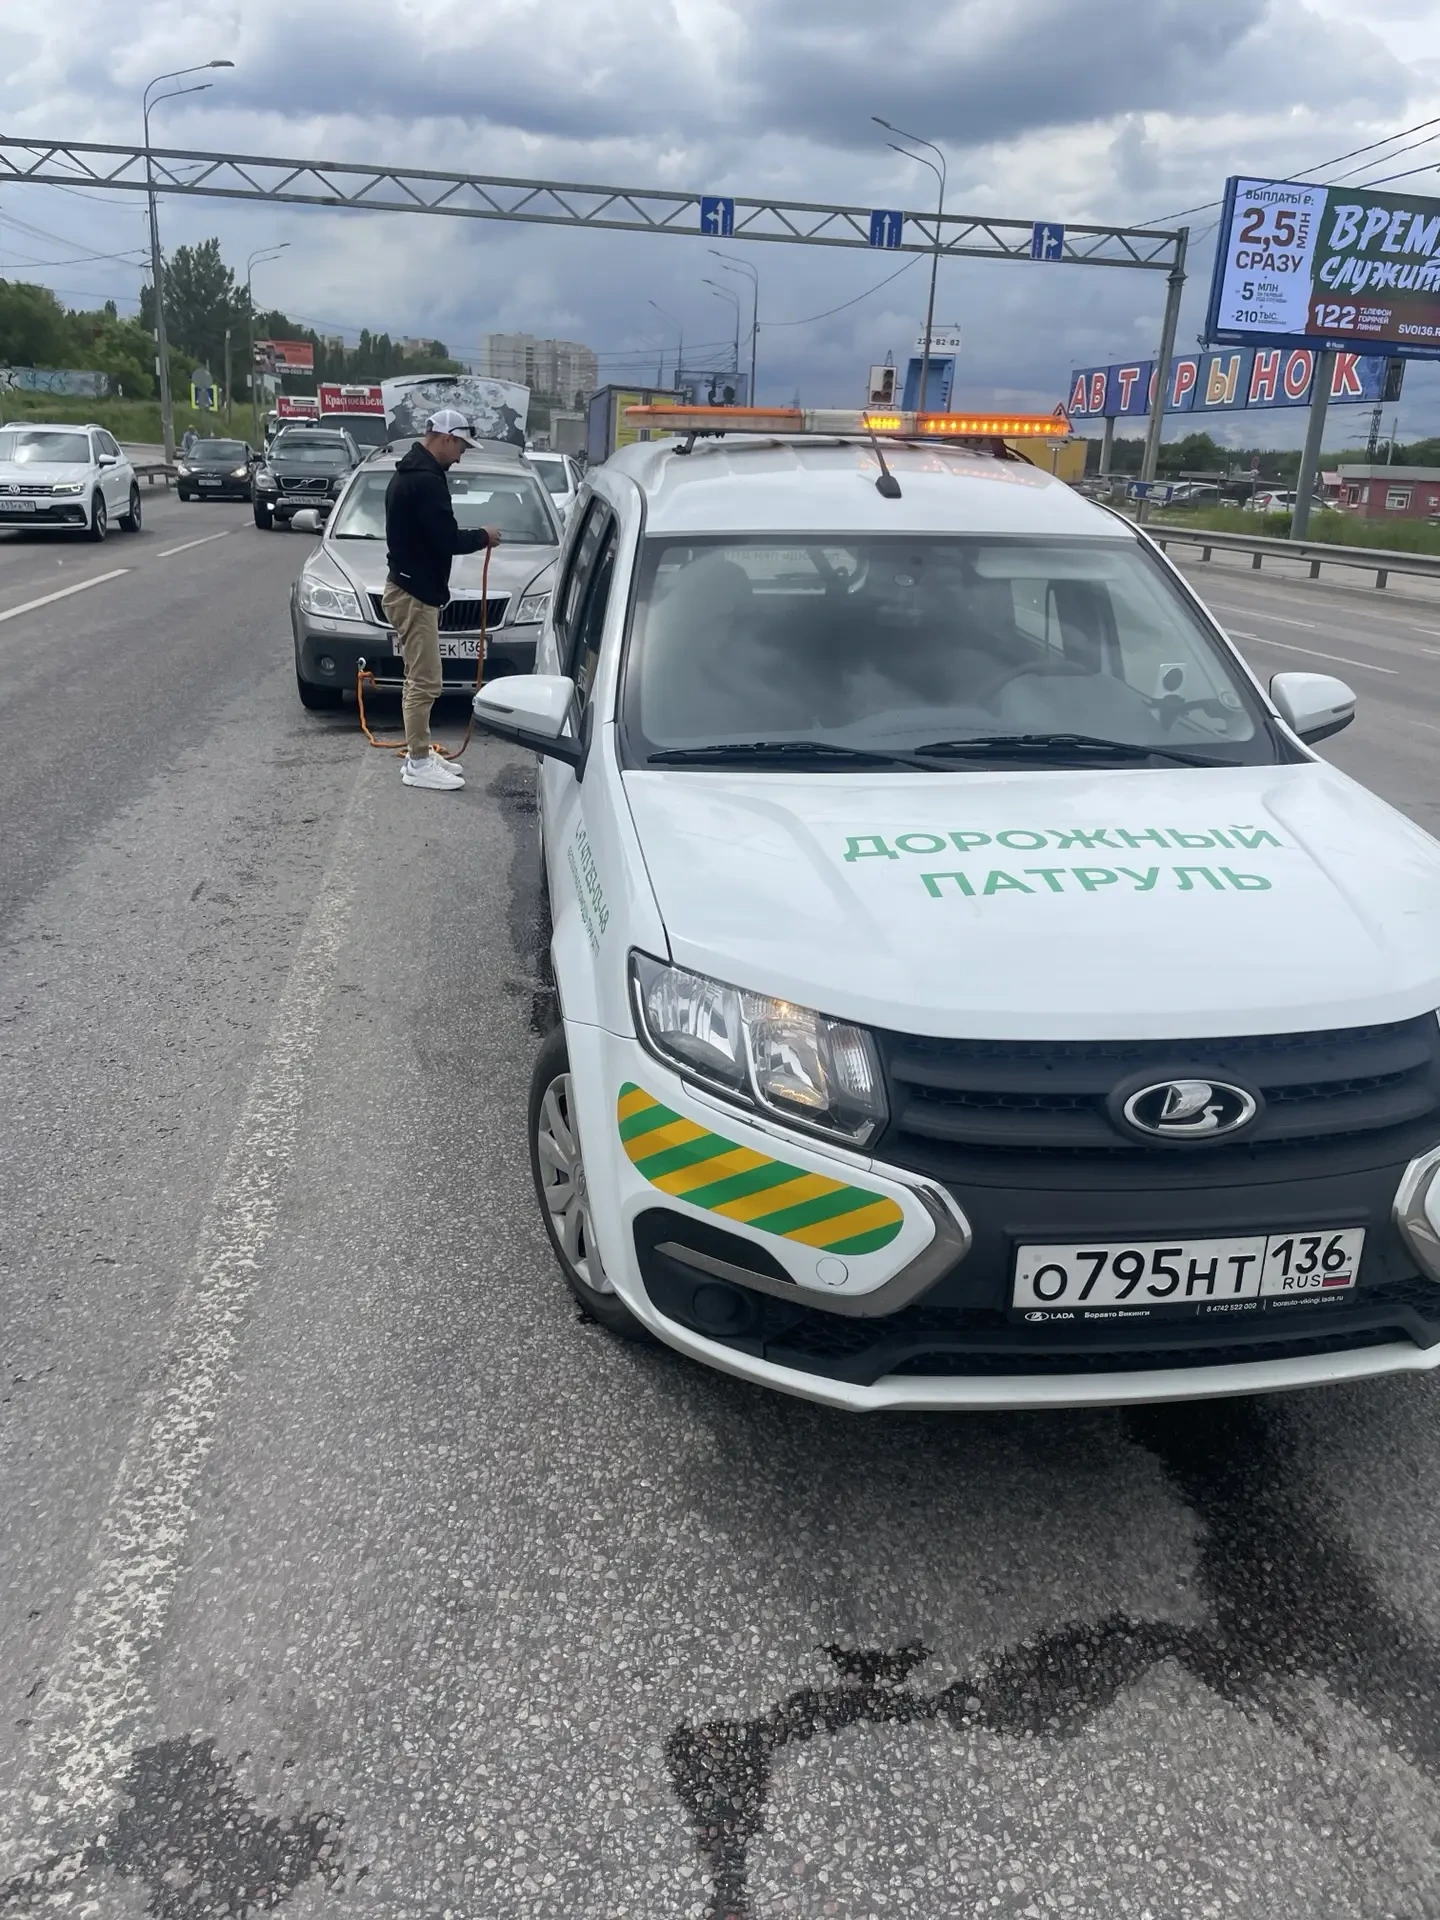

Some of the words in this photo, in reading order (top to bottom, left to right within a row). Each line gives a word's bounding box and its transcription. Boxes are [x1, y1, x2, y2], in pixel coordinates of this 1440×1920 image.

[1246, 190, 1301, 204] ВЫПЛАТЫ
[1239, 207, 1296, 251] 2,5
[1296, 212, 1311, 249] МЛН
[1327, 205, 1440, 258] ВРЕМ
[1235, 250, 1304, 273] СРАЗУ
[1241, 281, 1255, 301] 5
[1257, 282, 1279, 293] МЛН
[1235, 309, 1258, 323] 210
[1314, 303, 1356, 330] 122
[1358, 315, 1389, 325] ГОРЯЧЕЙ
[1359, 307, 1392, 317] ТЕЛЕФОН
[843, 824, 1284, 862] ДОРОЖНЫЙ
[919, 866, 1273, 898] ПАТРУЛЬ
[1271, 1234, 1347, 1277] 136
[1281, 1274, 1322, 1290] RUS
[1050, 1311, 1075, 1320] LADA
[1084, 1311, 1117, 1320] Боравто
[1118, 1310, 1151, 1318] Викинги
